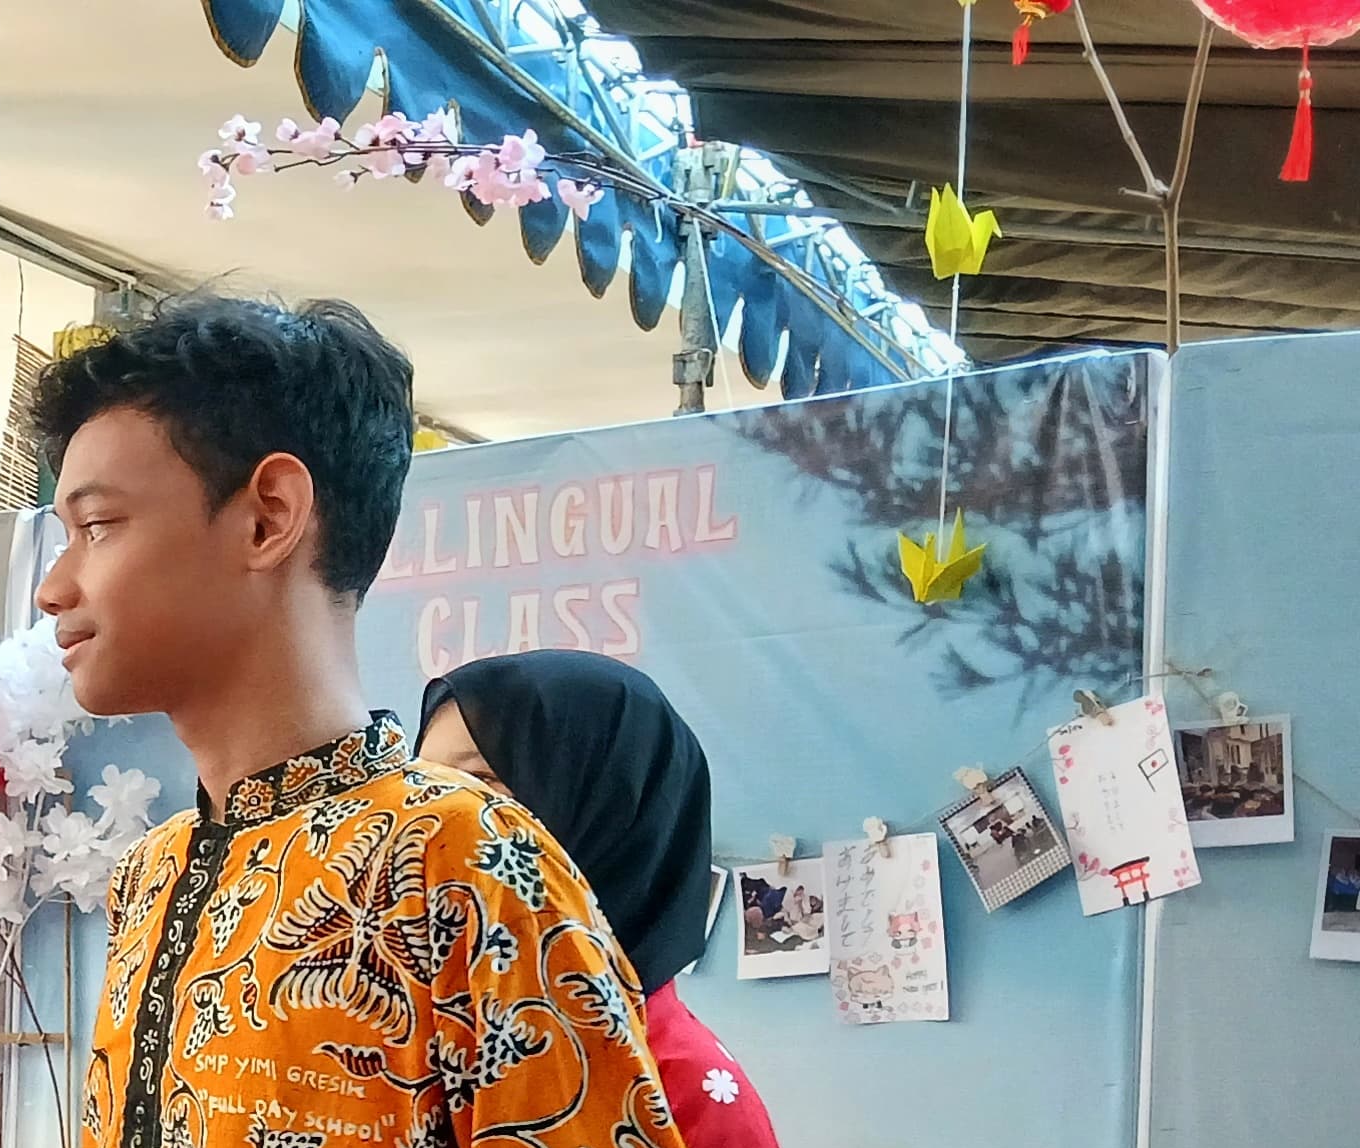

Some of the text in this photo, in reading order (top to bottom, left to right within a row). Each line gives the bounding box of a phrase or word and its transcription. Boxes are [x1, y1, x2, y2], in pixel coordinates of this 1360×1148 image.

[381, 464, 738, 580] LINGUAL
[416, 577, 641, 681] CLASS
[194, 1054, 367, 1098] SMP YIMI GRESIK
[255, 1099, 298, 1129] DAY
